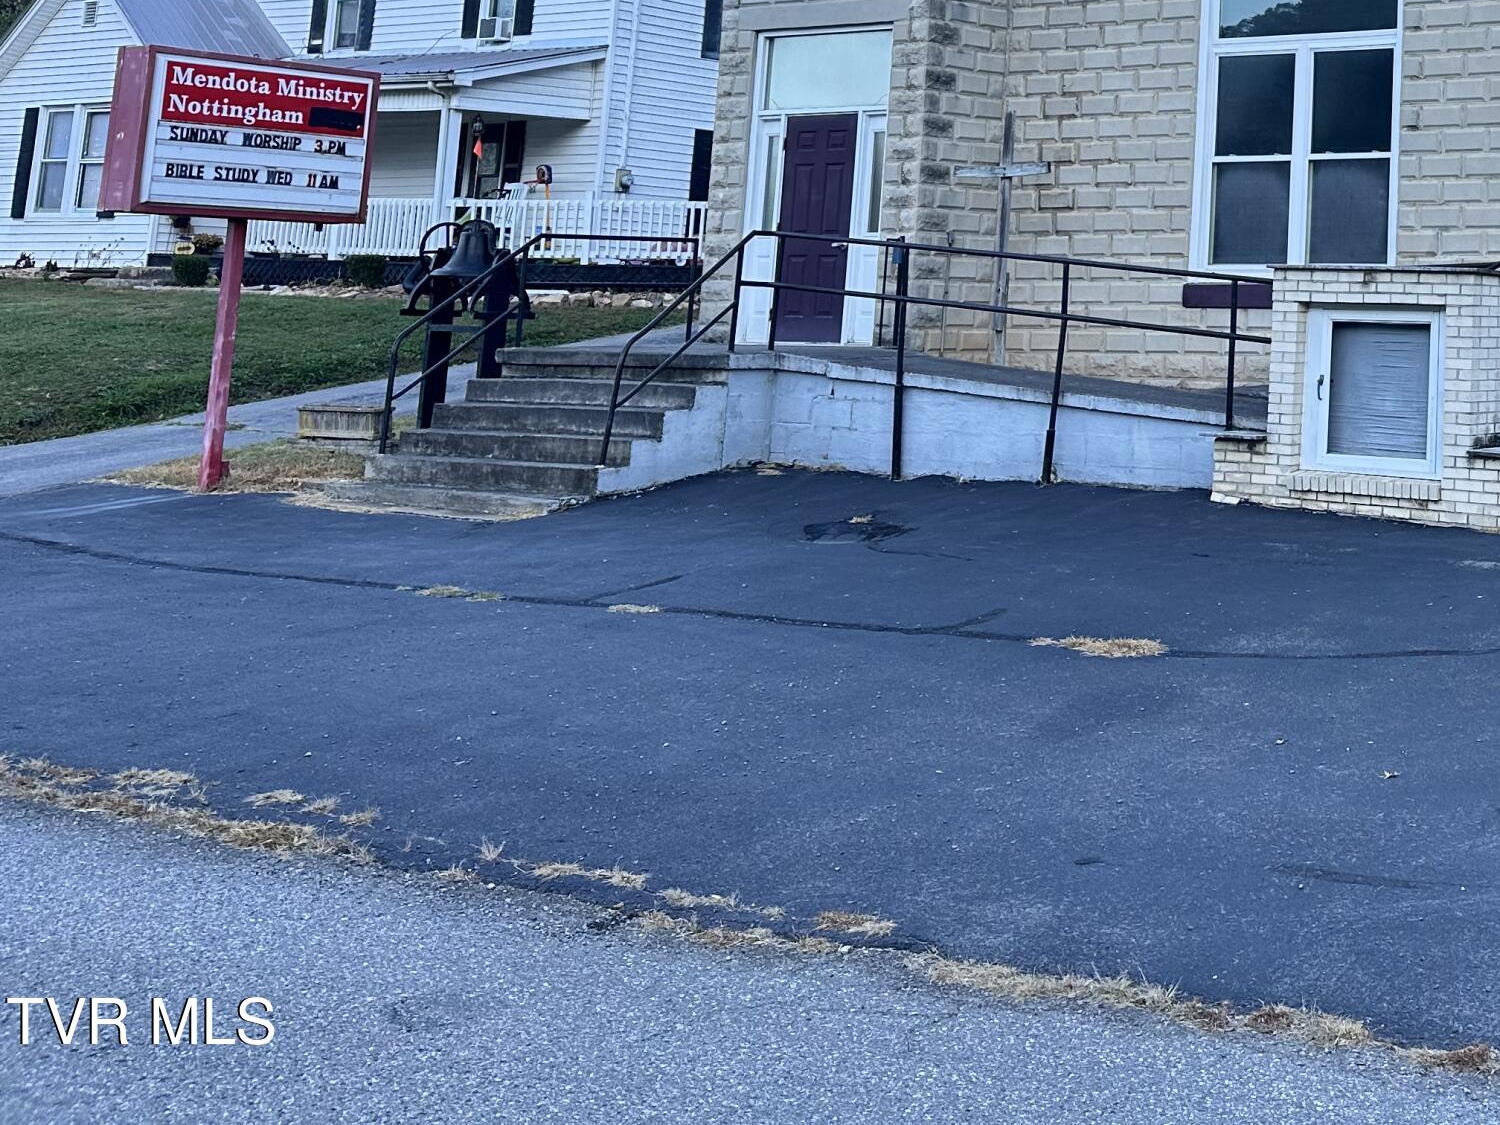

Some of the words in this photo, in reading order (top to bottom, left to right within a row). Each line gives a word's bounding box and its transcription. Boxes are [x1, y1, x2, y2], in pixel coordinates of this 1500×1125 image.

[171, 65, 271, 95] Mendota
[276, 78, 365, 110] Ministry
[167, 94, 304, 125] Nottingham
[169, 126, 228, 145] SUNDAY
[241, 132, 302, 152] WORSHIP
[165, 163, 204, 180] BIBLE
[213, 166, 259, 184] STUDY
[265, 169, 293, 186] WED
